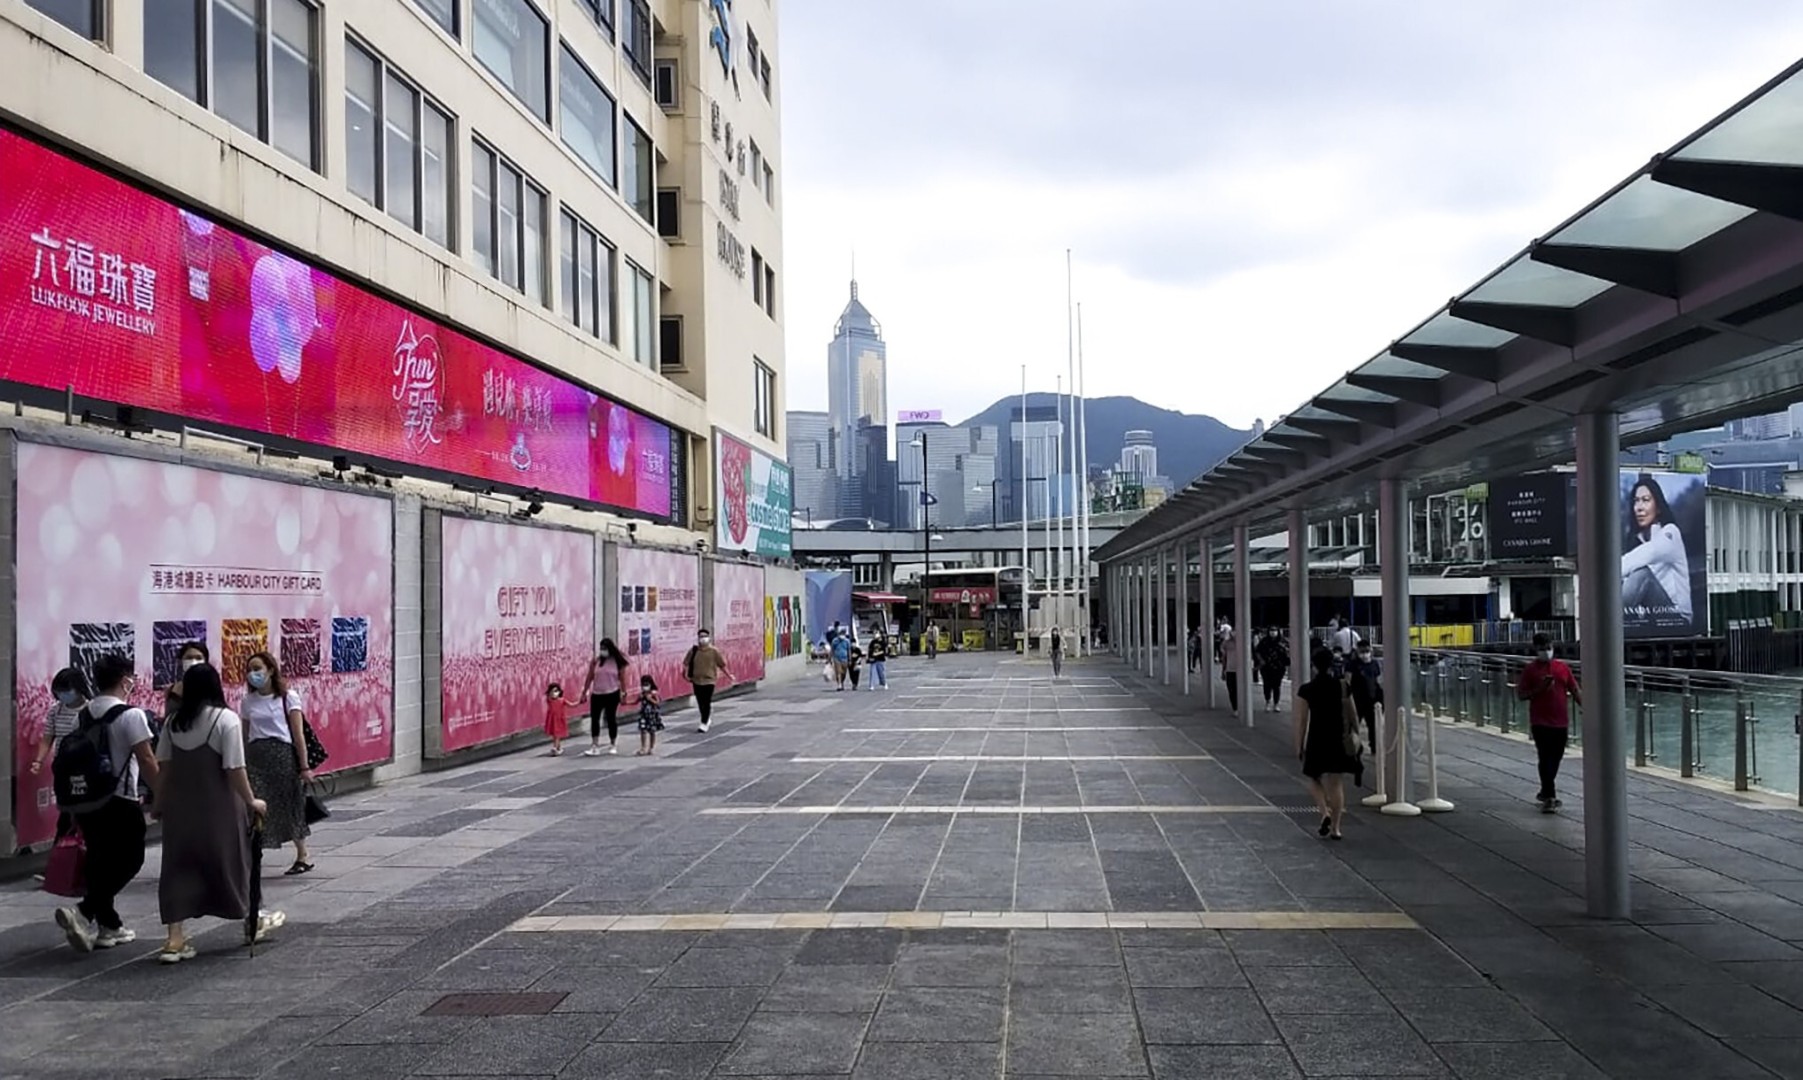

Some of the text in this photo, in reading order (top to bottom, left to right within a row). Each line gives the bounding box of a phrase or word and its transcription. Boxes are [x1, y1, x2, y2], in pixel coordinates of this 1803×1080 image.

[30, 227, 157, 315] 六福珠寶
[92, 302, 156, 336] JEWELLERY
[217, 573, 262, 589] HARBOUR
[262, 575, 282, 591] CITY
[282, 576, 300, 591] GIFT
[301, 577, 322, 591] CARD
[497, 585, 557, 618] GIFT YOU
[483, 624, 566, 661] EVERYTHING
